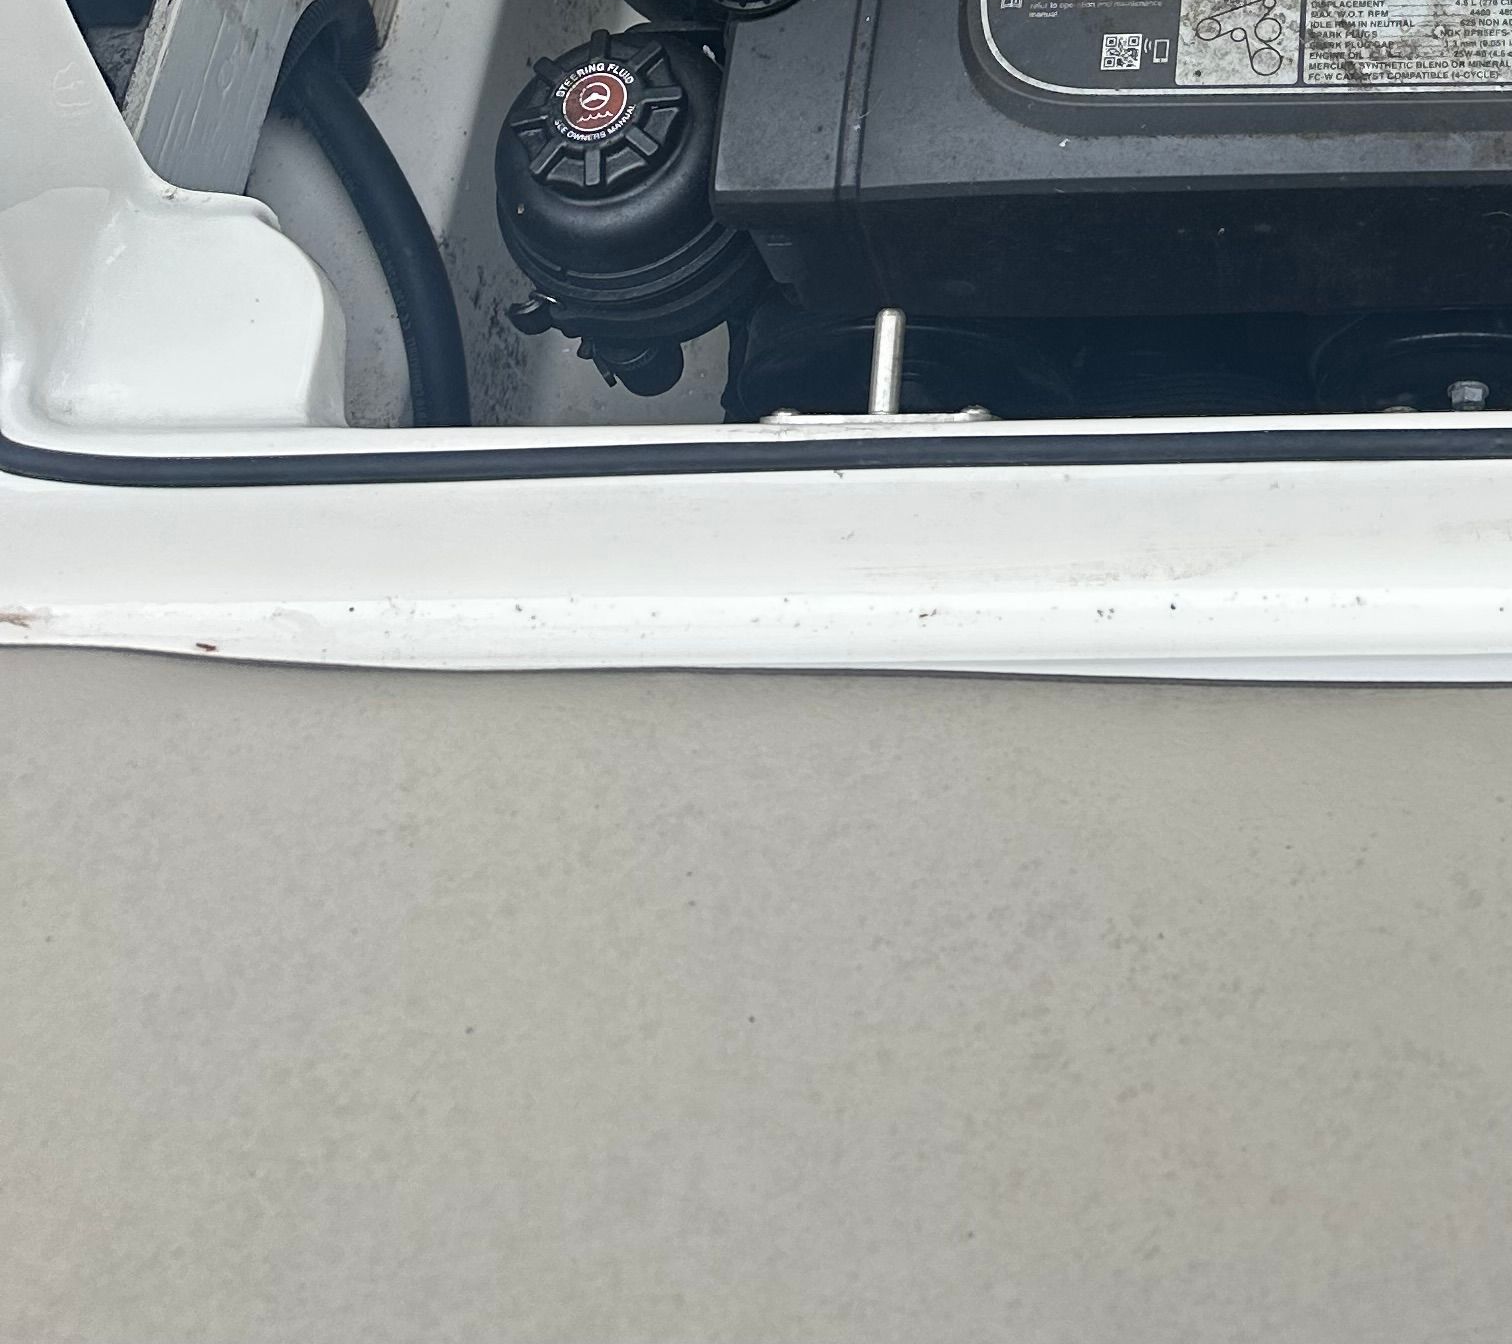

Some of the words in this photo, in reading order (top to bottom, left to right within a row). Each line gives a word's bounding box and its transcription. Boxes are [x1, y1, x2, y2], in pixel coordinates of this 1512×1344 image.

[1311, 0, 1385, 8] DISPLACEMENT
[1370, 19, 1415, 27] NEUTRAL
[556, 63, 605, 98] STEERING
[607, 63, 635, 85] FLUID
[554, 119, 567, 135] SEE
[607, 104, 636, 134] MANUAL
